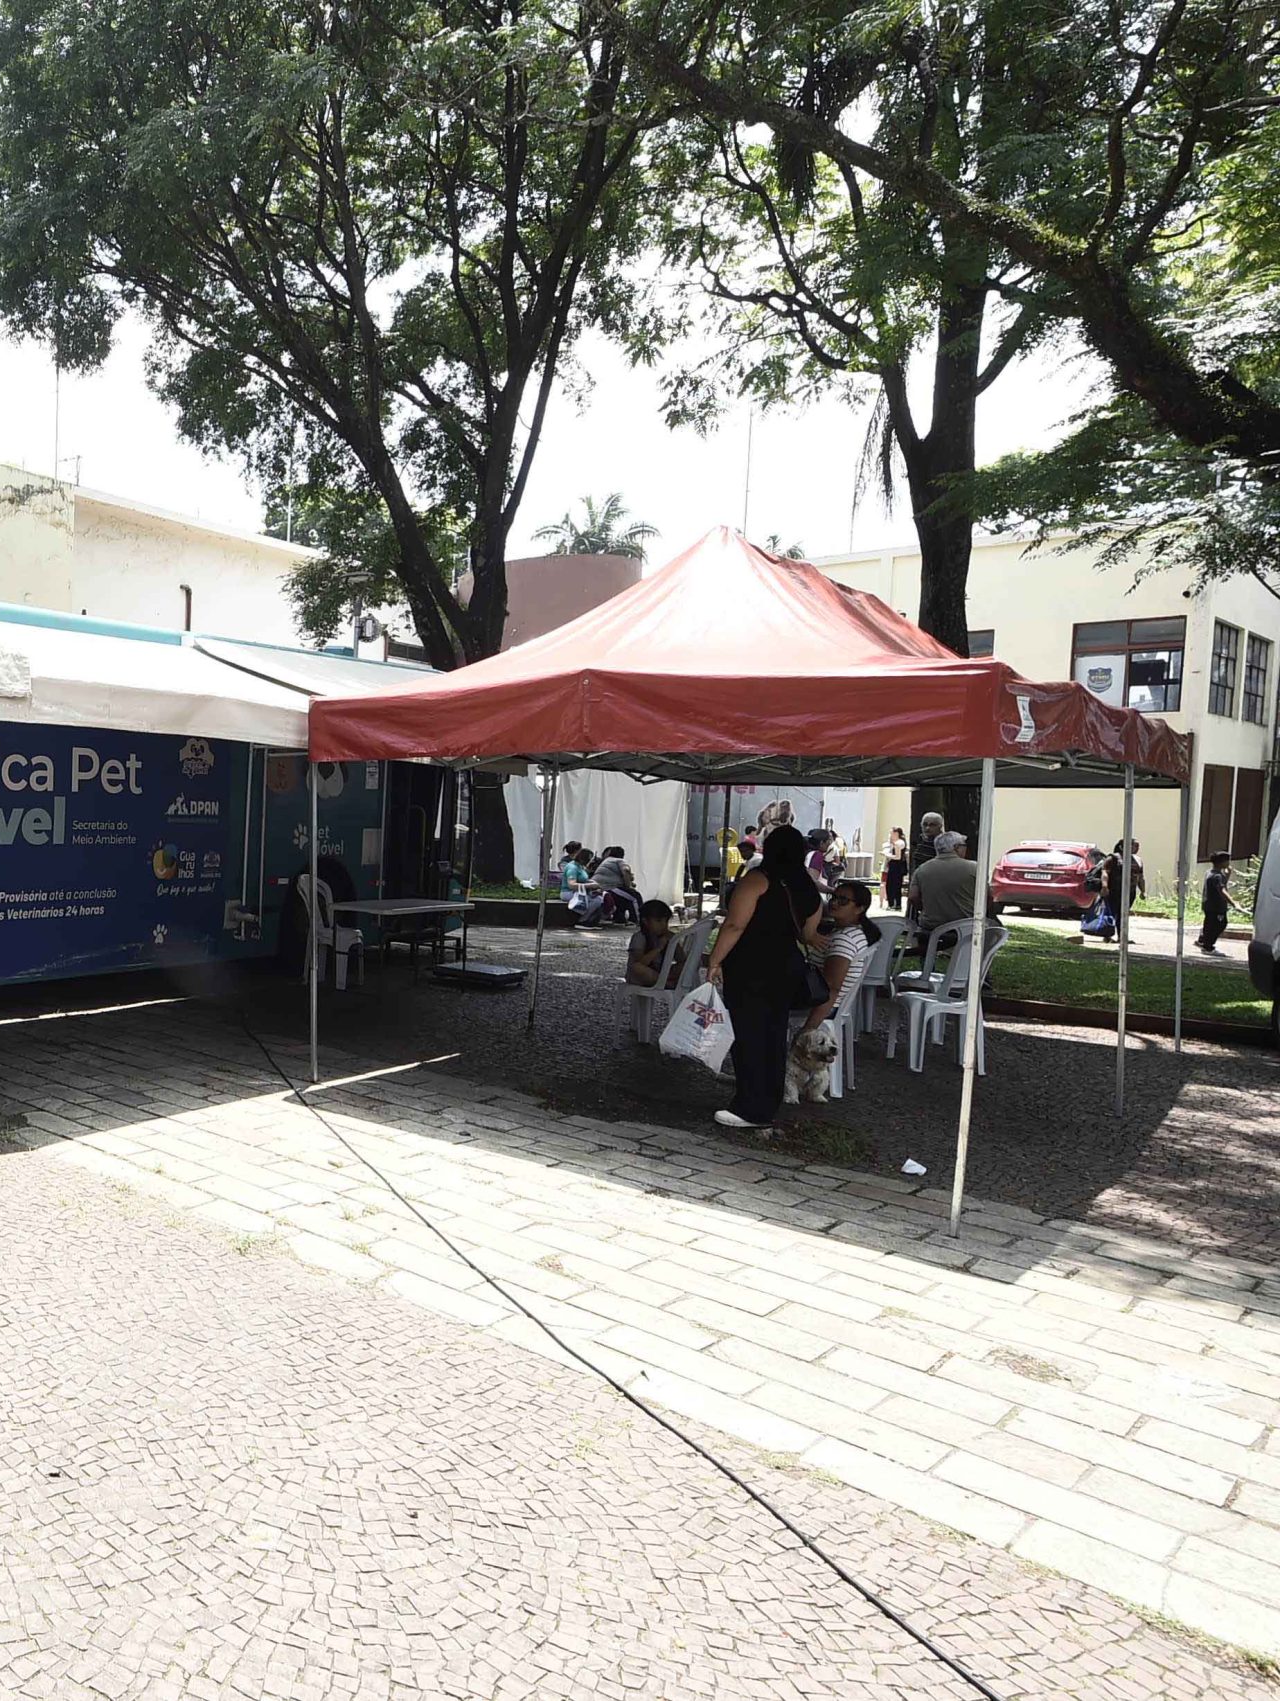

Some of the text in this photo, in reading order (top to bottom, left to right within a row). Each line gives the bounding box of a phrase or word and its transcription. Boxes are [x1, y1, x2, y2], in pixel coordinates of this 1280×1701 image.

[71, 747, 143, 795] Pet
[190, 801, 219, 815] DPAN
[72, 820, 128, 831] Secretaria do
[72, 834, 137, 845] Meio Ambiente
[179, 851, 196, 861] Gua
[48, 889, 64, 901] até
[65, 891, 73, 900] a
[73, 888, 117, 900] conclusão
[6, 906, 64, 921] Veterinários
[65, 905, 78, 917] 24
[79, 905, 105, 916] horas
